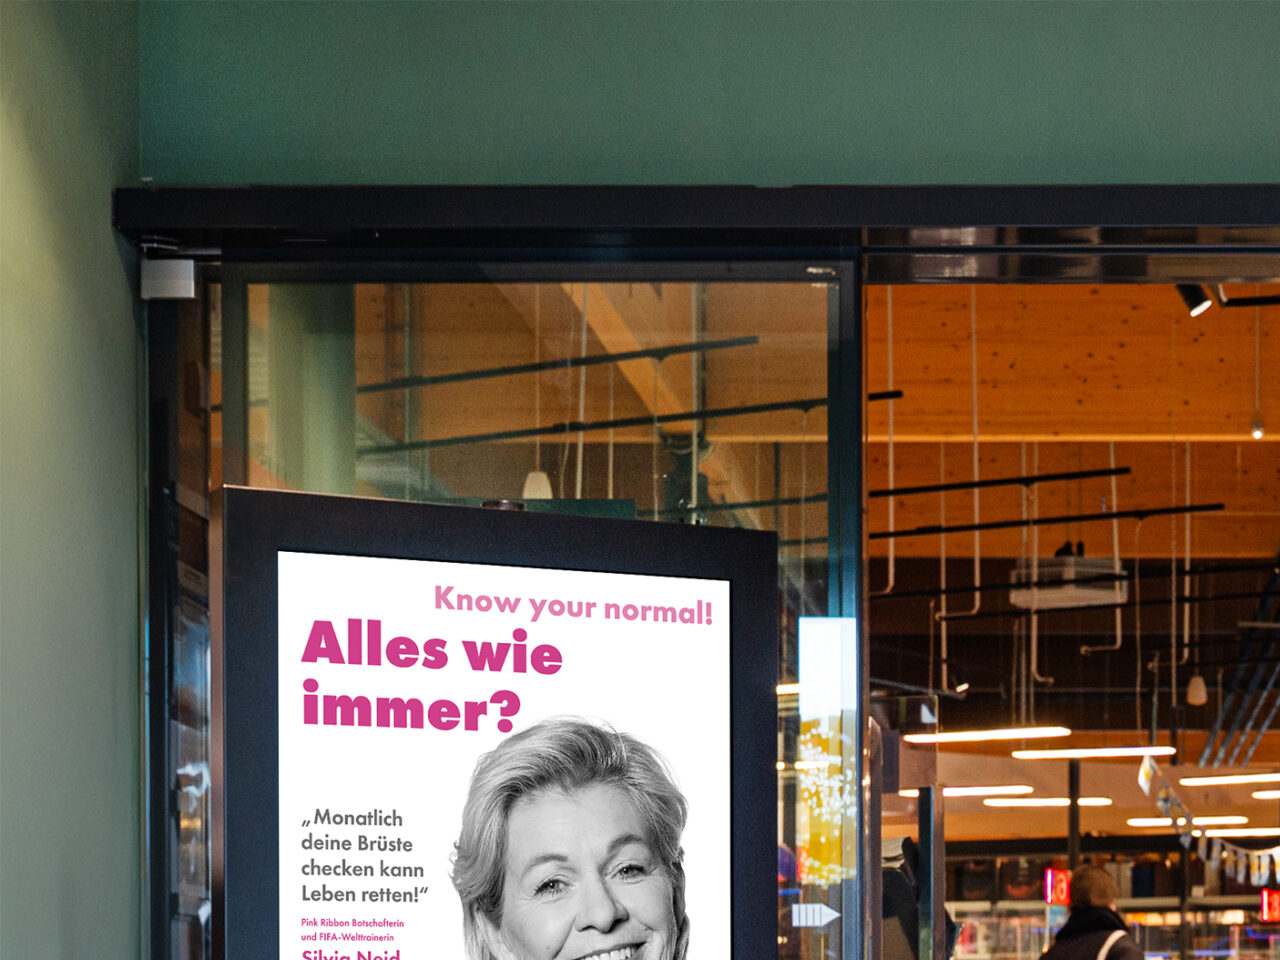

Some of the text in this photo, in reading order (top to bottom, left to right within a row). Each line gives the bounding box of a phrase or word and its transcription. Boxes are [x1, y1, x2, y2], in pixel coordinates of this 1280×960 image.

[435, 585, 712, 625] Know your normal!
[301, 618, 562, 675] Alles wie
[303, 678, 520, 733] immer?
[301, 834, 412, 852] deine Brüste
[302, 858, 423, 877] checken kann
[302, 884, 355, 901] Leben
[301, 918, 404, 927] Pink Ribbon Botschafterin
[301, 932, 394, 941] und FIFA-Welttrainerin
